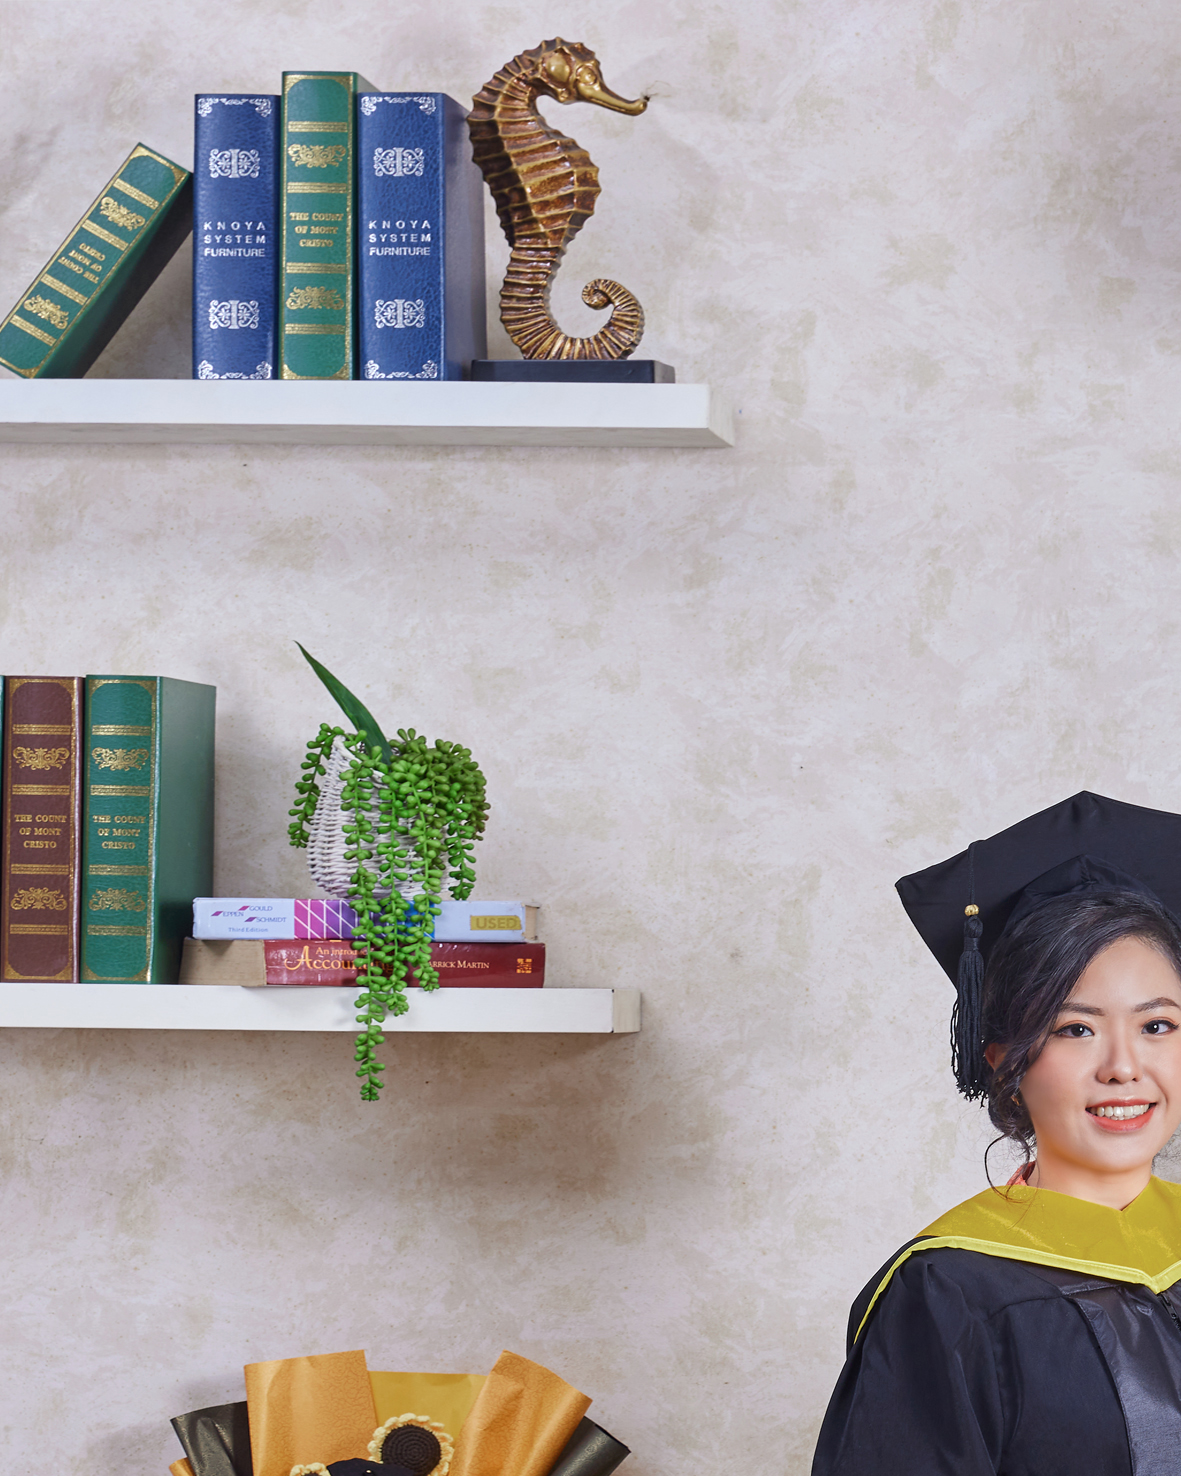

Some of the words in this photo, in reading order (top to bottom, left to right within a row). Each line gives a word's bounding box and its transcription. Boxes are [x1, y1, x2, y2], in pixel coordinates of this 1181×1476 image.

[289, 212, 309, 221] THE
[312, 213, 344, 221] COUNT
[203, 221, 266, 231] KNOYA
[368, 220, 431, 229] KNOYA
[294, 226, 308, 234] OF
[310, 226, 339, 234] MONT
[204, 235, 266, 244] SYSTEM
[368, 233, 431, 243] SYSTEM
[299, 239, 334, 247] CRISTO
[204, 248, 266, 257] FURNITURE
[369, 247, 431, 256] FURNITURE
[14, 814, 33, 823] THE
[35, 815, 67, 823] COUNT
[92, 815, 111, 823] THE
[114, 815, 147, 824] COUNT
[19, 827, 32, 836] OF
[34, 828, 62, 836] MONT
[97, 828, 110, 836] OF
[112, 828, 141, 837] MONT
[23, 840, 57, 849] CRISTO
[101, 841, 136, 850] CRISTO
[476, 917, 517, 930] USED
[316, 947, 330, 955] An
[428, 961, 456, 969] ARRICK
[457, 960, 490, 969] MARTIN
